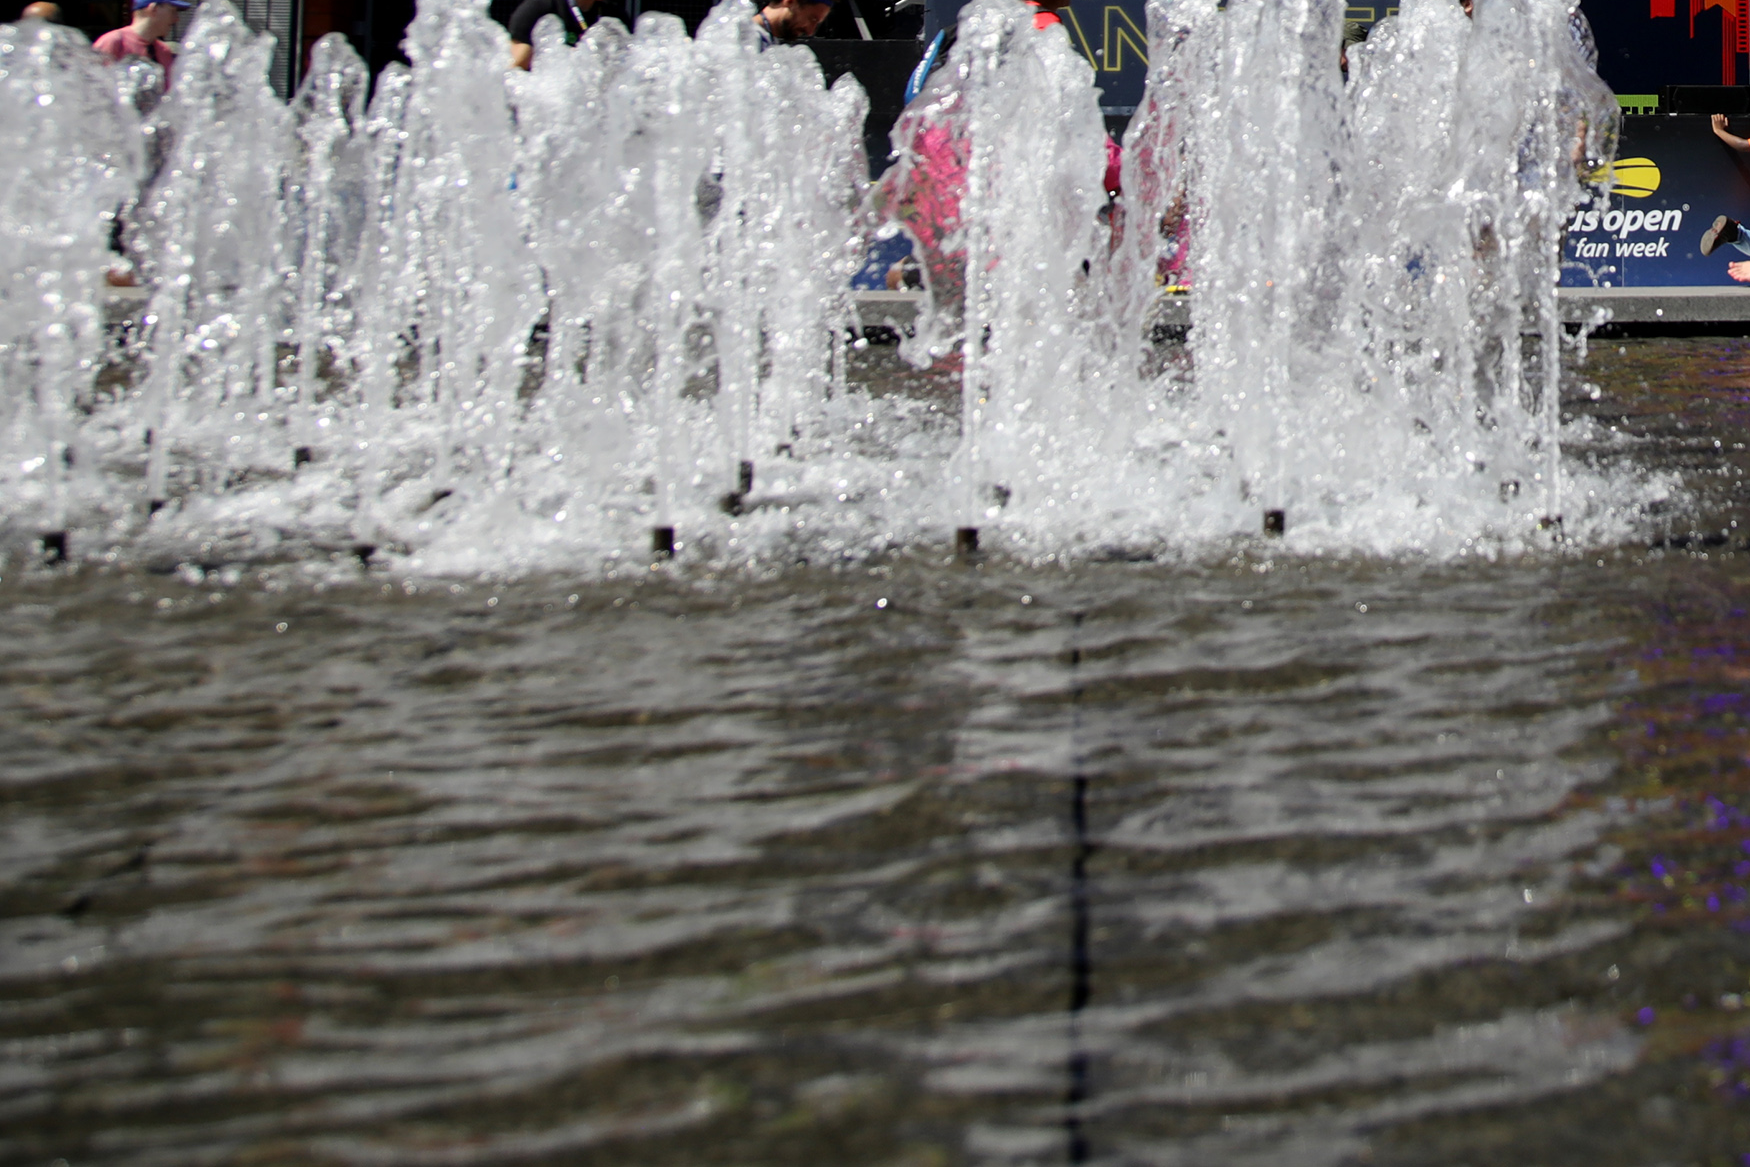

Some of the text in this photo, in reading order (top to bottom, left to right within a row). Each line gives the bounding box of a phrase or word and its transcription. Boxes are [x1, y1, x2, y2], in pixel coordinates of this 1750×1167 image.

[1603, 210, 1682, 239] open
[1575, 237, 1670, 258] fan week
